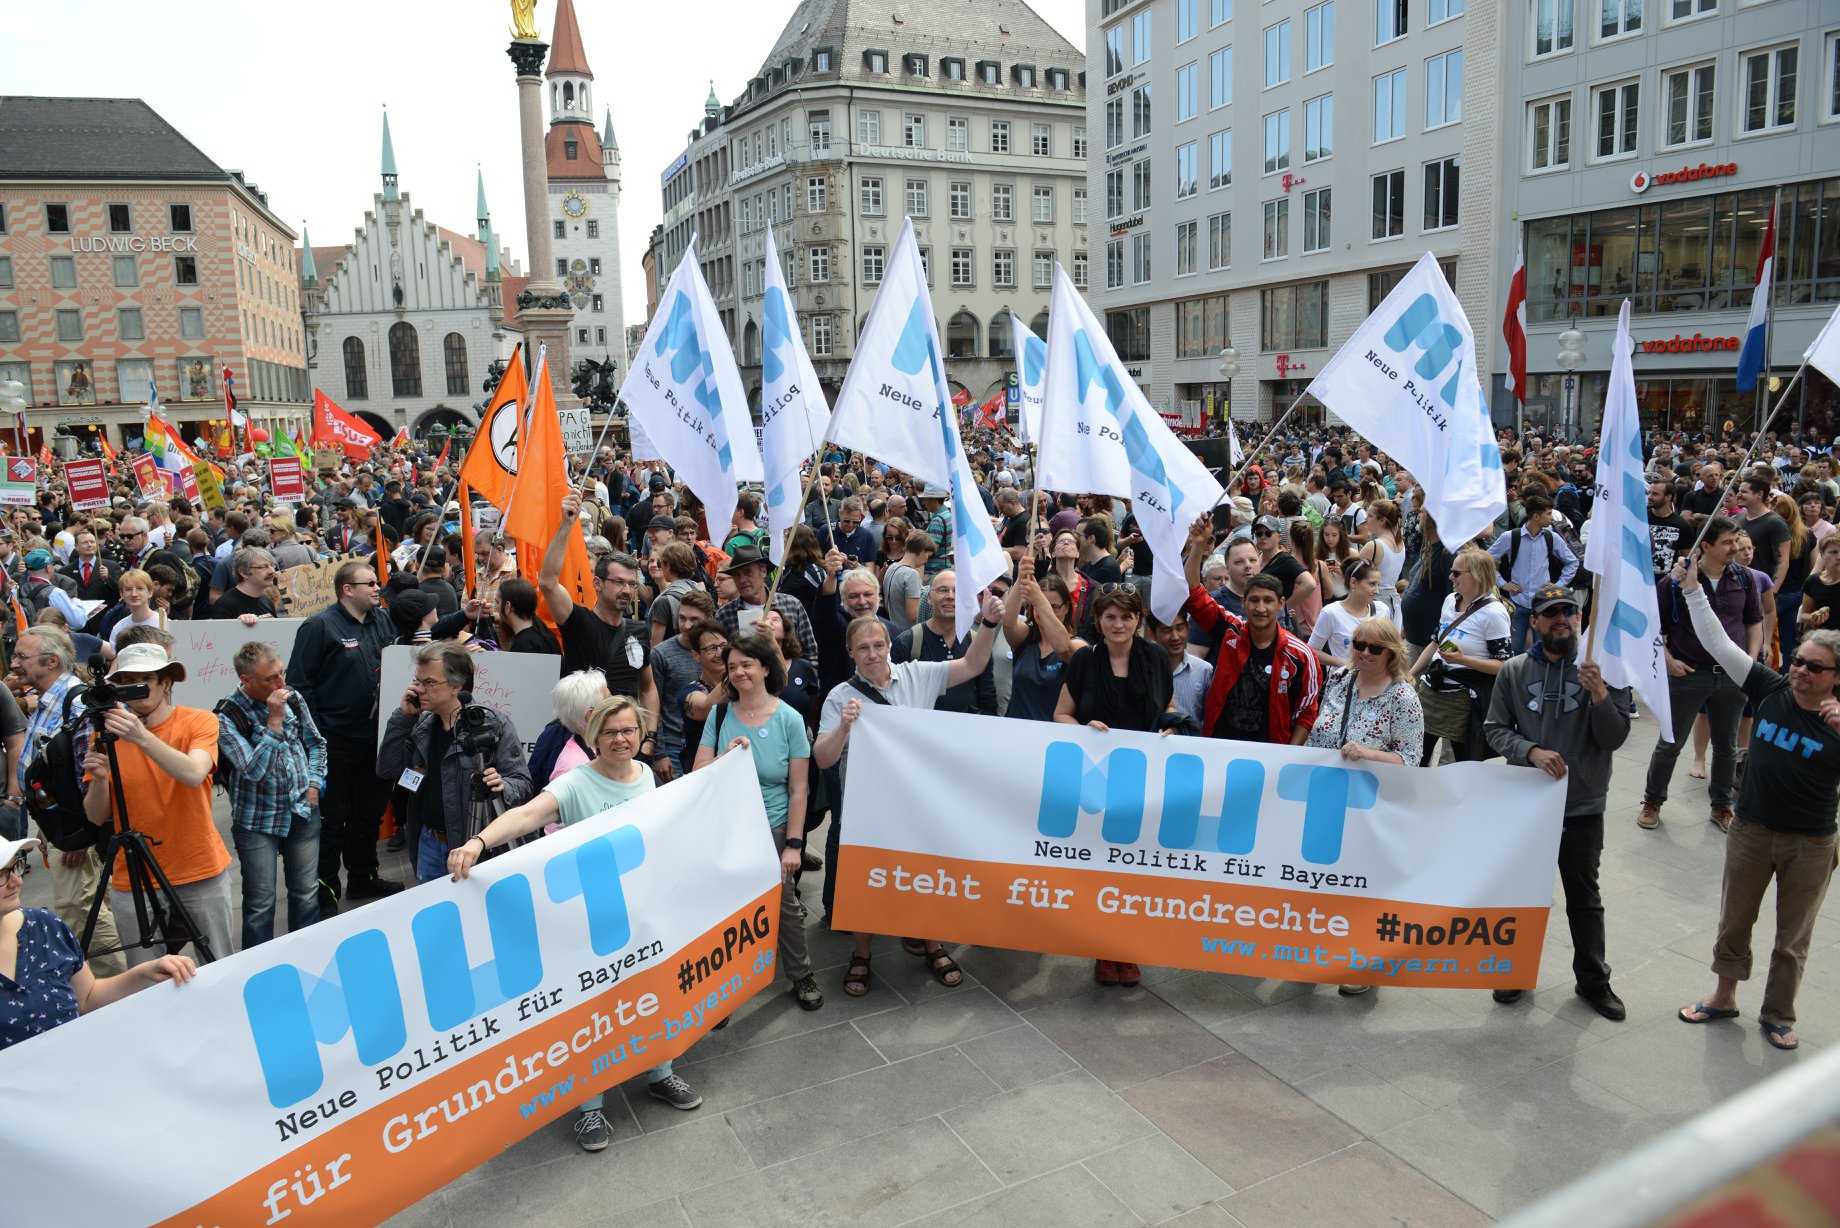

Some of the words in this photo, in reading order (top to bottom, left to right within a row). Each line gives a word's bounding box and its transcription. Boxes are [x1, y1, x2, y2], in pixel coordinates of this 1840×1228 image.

[1107, 74, 1134, 96] BEYOND
[860, 142, 931, 160] Deutsche
[937, 148, 974, 162] Bank
[732, 161, 764, 183] Deutsche
[764, 152, 786, 172] Bank
[1656, 162, 1737, 185] vodafone
[1109, 215, 1144, 233] Hugendubel
[70, 237, 146, 252] LUDWIG
[150, 237, 199, 252] BECK
[1642, 333, 1740, 353] vodafone
[1009, 373, 1018, 385] S
[1364, 349, 1398, 381] Neue
[879, 383, 922, 411] Neue
[1010, 388, 1018, 400] U
[83, 500, 106, 508] PARTEI
[1137, 491, 1167, 513] für
[189, 632, 214, 652] We
[1755, 718, 1824, 760] MUT
[1037, 741, 1380, 866] MUT
[1034, 840, 1092, 862] Neue
[1107, 847, 1207, 872] Politik
[1223, 857, 1266, 878] für
[1280, 864, 1368, 890] Bayern
[867, 864, 982, 900] steht
[1006, 878, 1074, 910] für
[1097, 886, 1350, 937] Grundrechte
[1375, 911, 1518, 946] #noPAG
[242, 823, 646, 1110] MUT
[1200, 935, 1513, 977] www.mut-bayern.de
[274, 1089, 358, 1142] Neue
[375, 1015, 501, 1091] Politik
[517, 985, 564, 1022] für
[577, 939, 664, 992] Bayern
[518, 947, 775, 1120] www.mut-bayern.de
[262, 1152, 353, 1227] für
[382, 991, 660, 1154] Grundrechte
[676, 904, 771, 996] #noPAG
